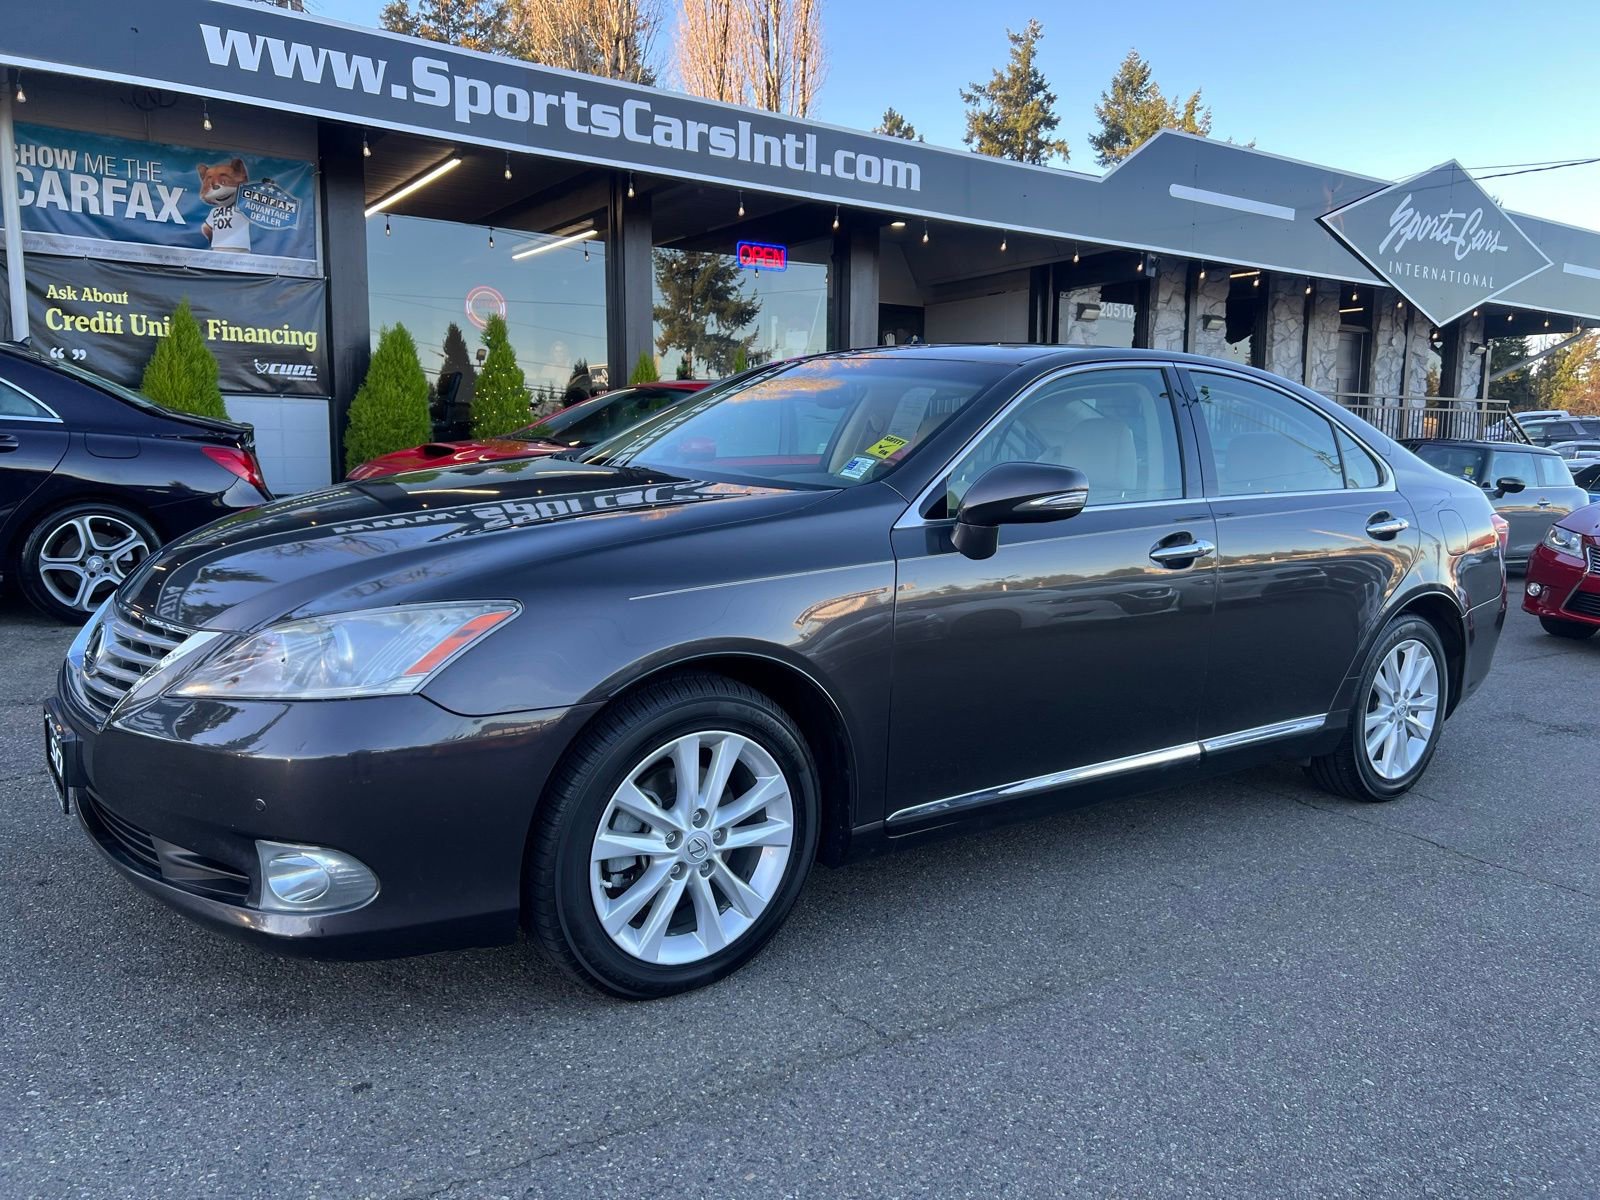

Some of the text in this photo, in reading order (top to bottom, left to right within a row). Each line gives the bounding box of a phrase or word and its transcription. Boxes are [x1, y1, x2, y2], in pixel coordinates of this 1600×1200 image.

[199, 23, 921, 192] www.SportsCarsIntl.com
[84, 152, 118, 177] ME
[122, 158, 162, 183] THE
[16, 166, 187, 225] CARFAX
[243, 190, 296, 213] CARFAX
[212, 206, 233, 218] CAR
[244, 201, 291, 221] ADVANTAGE
[250, 211, 281, 227] DEALER
[213, 217, 233, 230] FOX
[1379, 193, 1509, 261] Sports Cars
[740, 245, 785, 268] OPEN
[1388, 260, 1495, 289] INTERNATIONAL
[46, 284, 129, 305] Ask About
[1099, 302, 1134, 319] 20510
[45, 307, 318, 352] Credit Uni Financing
